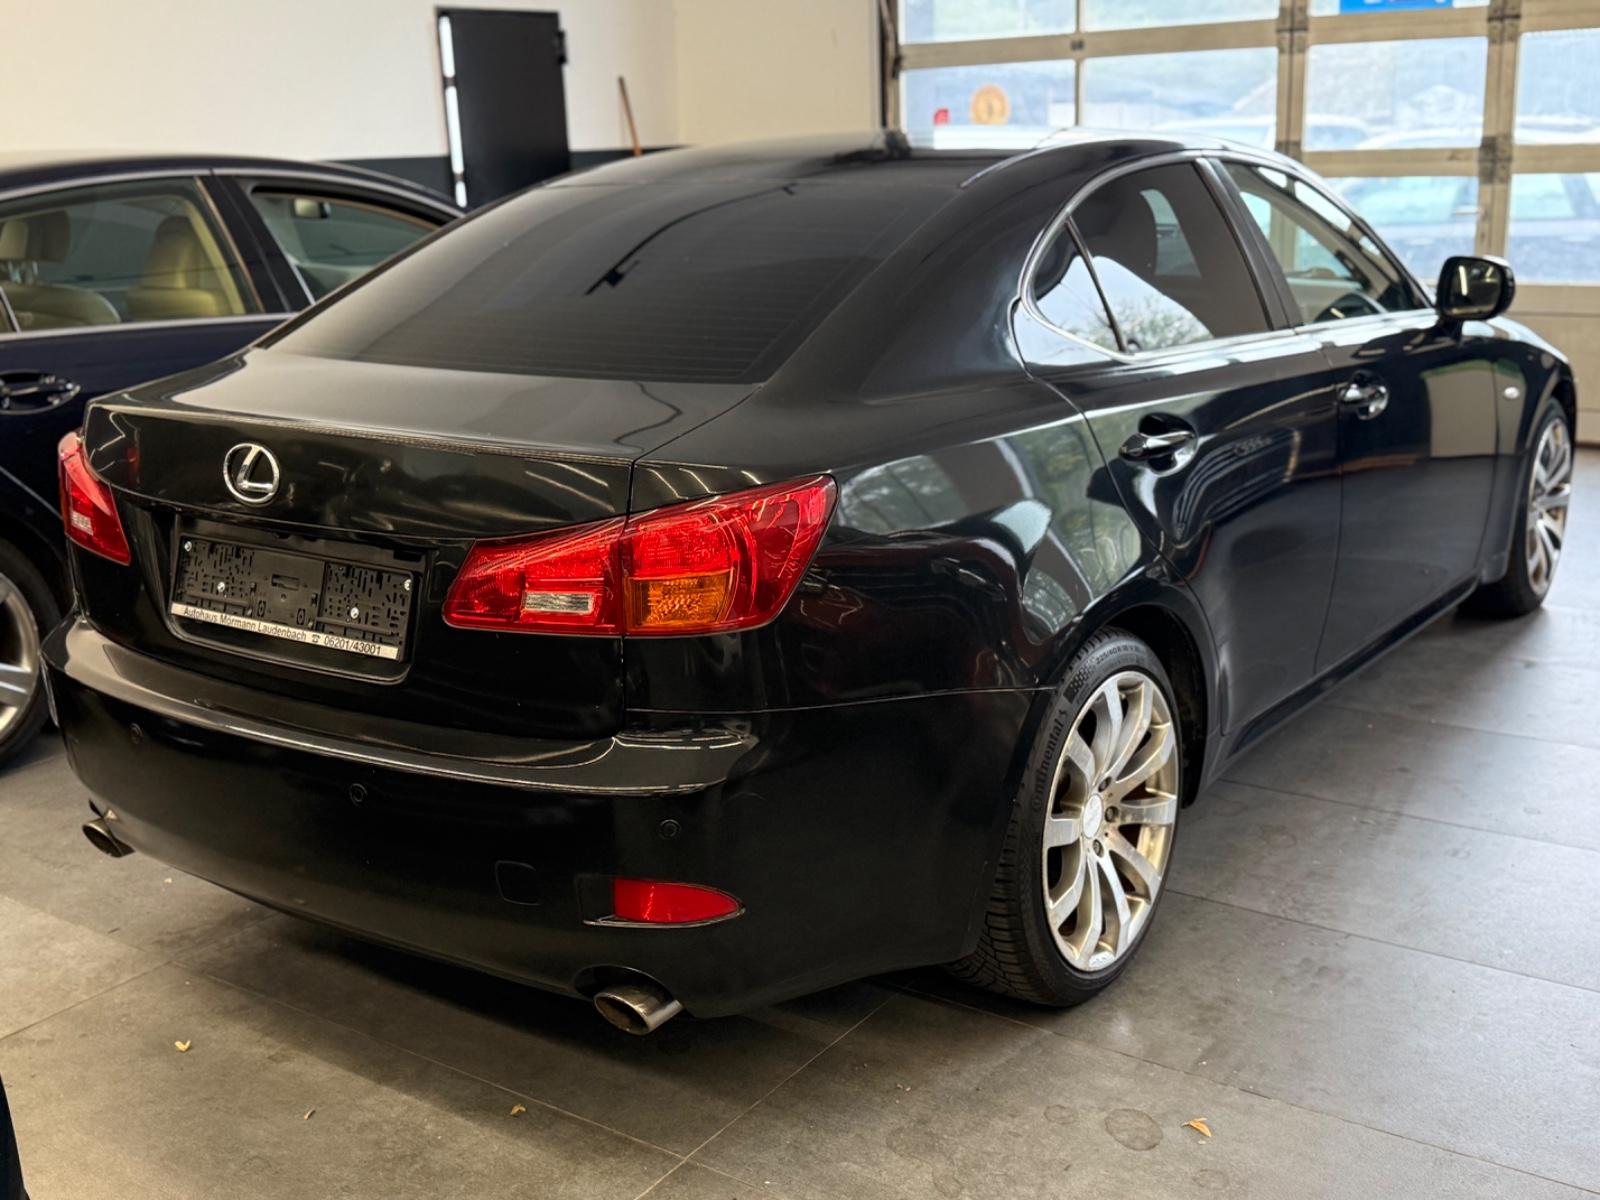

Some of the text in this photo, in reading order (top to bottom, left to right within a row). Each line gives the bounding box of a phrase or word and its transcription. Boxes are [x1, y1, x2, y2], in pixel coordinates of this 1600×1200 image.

[184, 607, 218, 622] Autohaus
[258, 621, 307, 641] Laudenbach
[324, 635, 381, 656] 06201/43001
